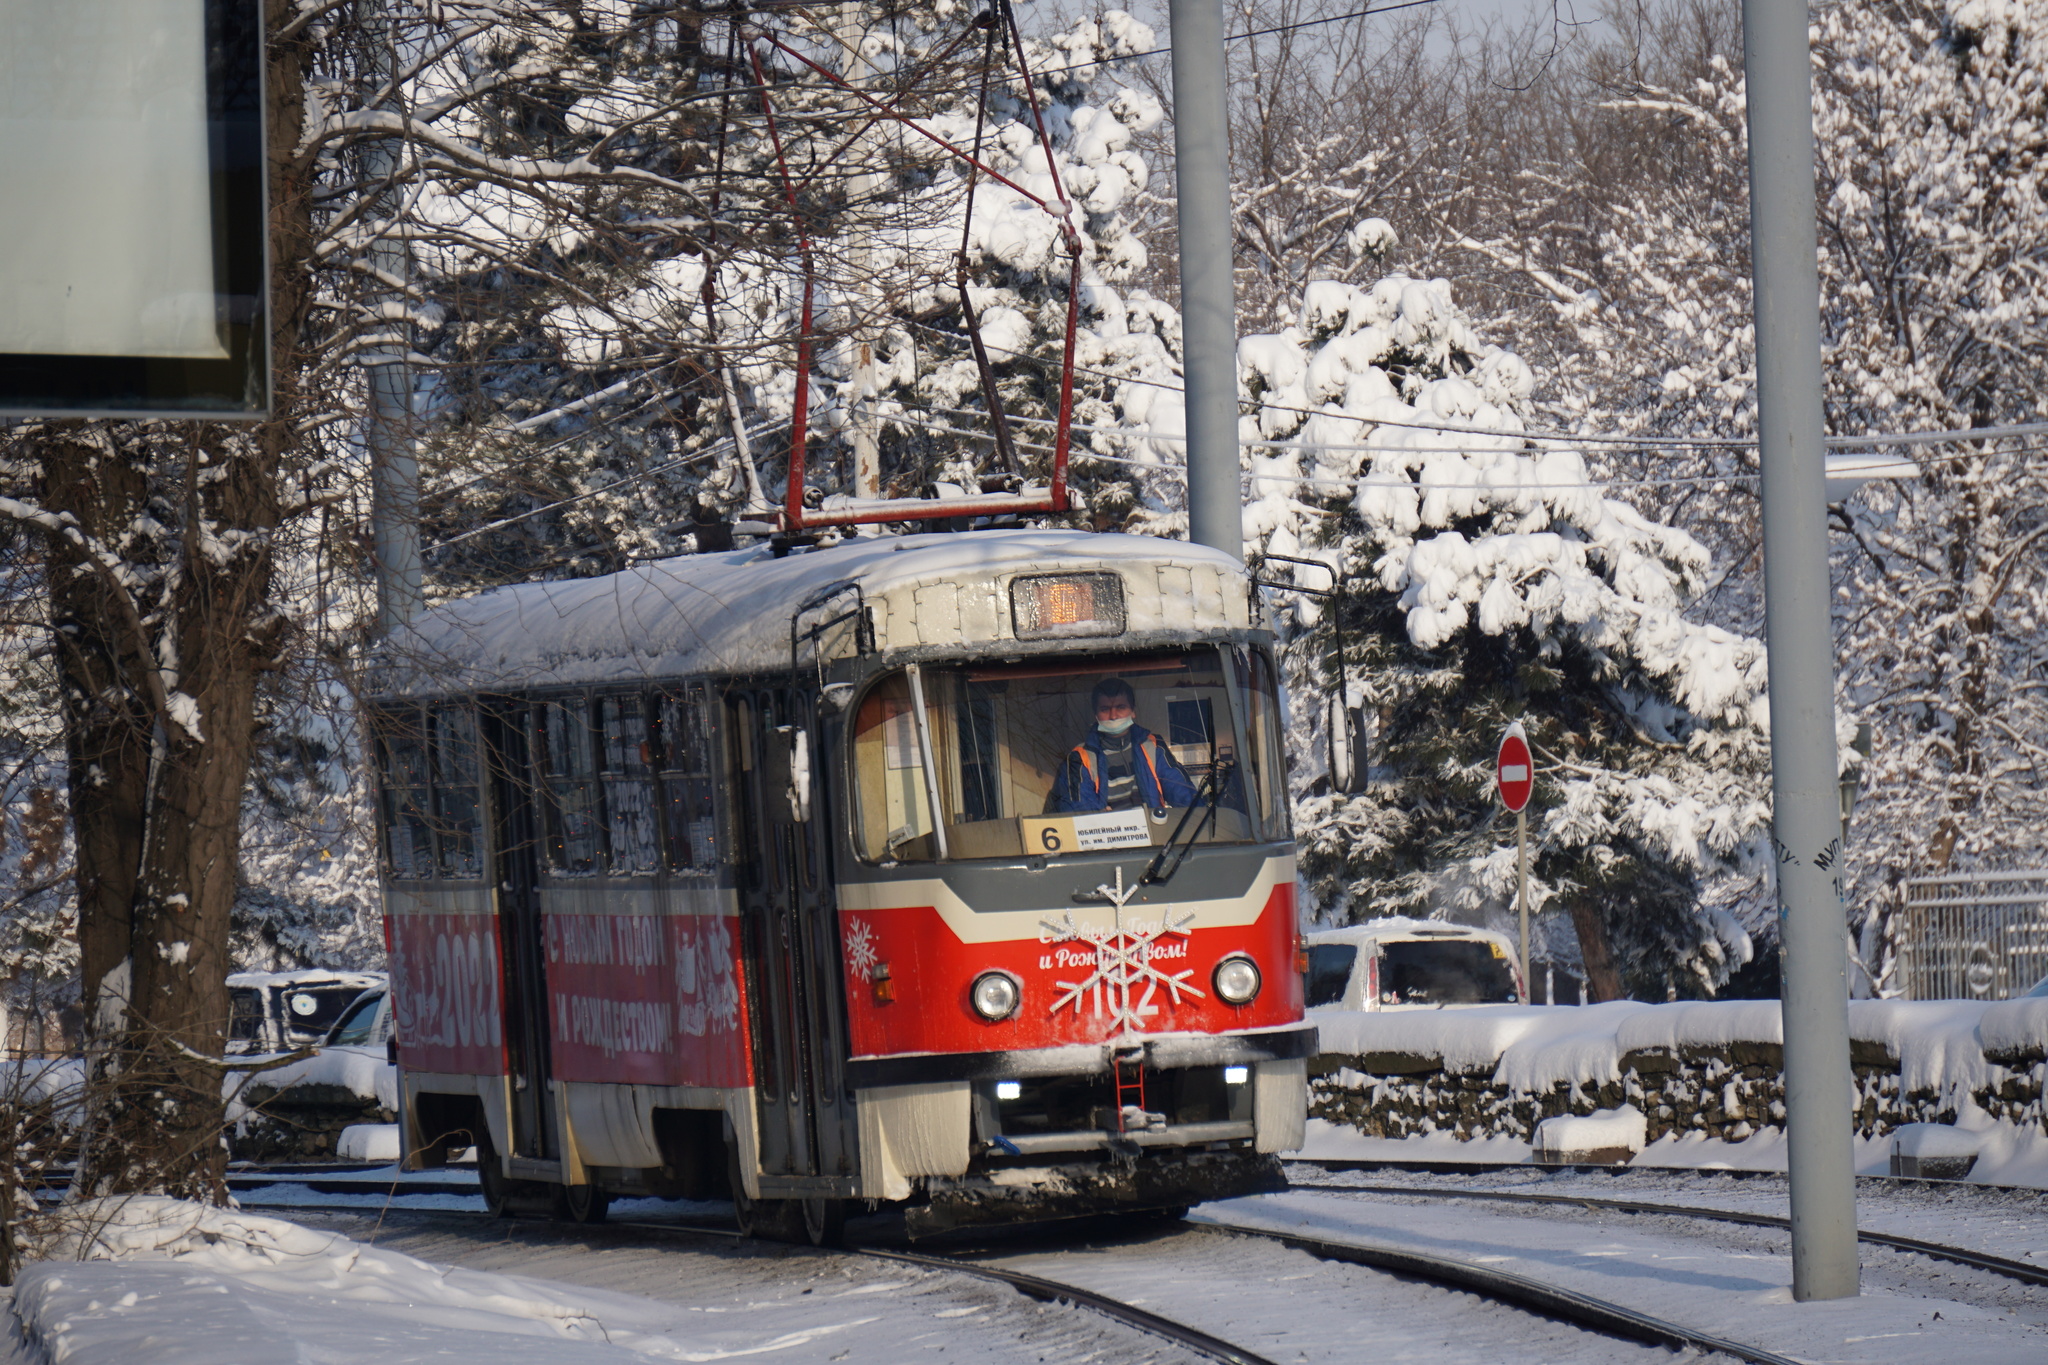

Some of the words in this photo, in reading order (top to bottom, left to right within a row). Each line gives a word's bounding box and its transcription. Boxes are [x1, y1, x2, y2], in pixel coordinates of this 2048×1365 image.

[1041, 826, 1061, 851] 6
[1077, 825, 1122, 836] ЮБИЛЕЙНЫЙ
[1123, 825, 1140, 833] мкр.
[1107, 833, 1148, 843] ДИМИТРОВА
[1092, 967, 1159, 1019] 102
